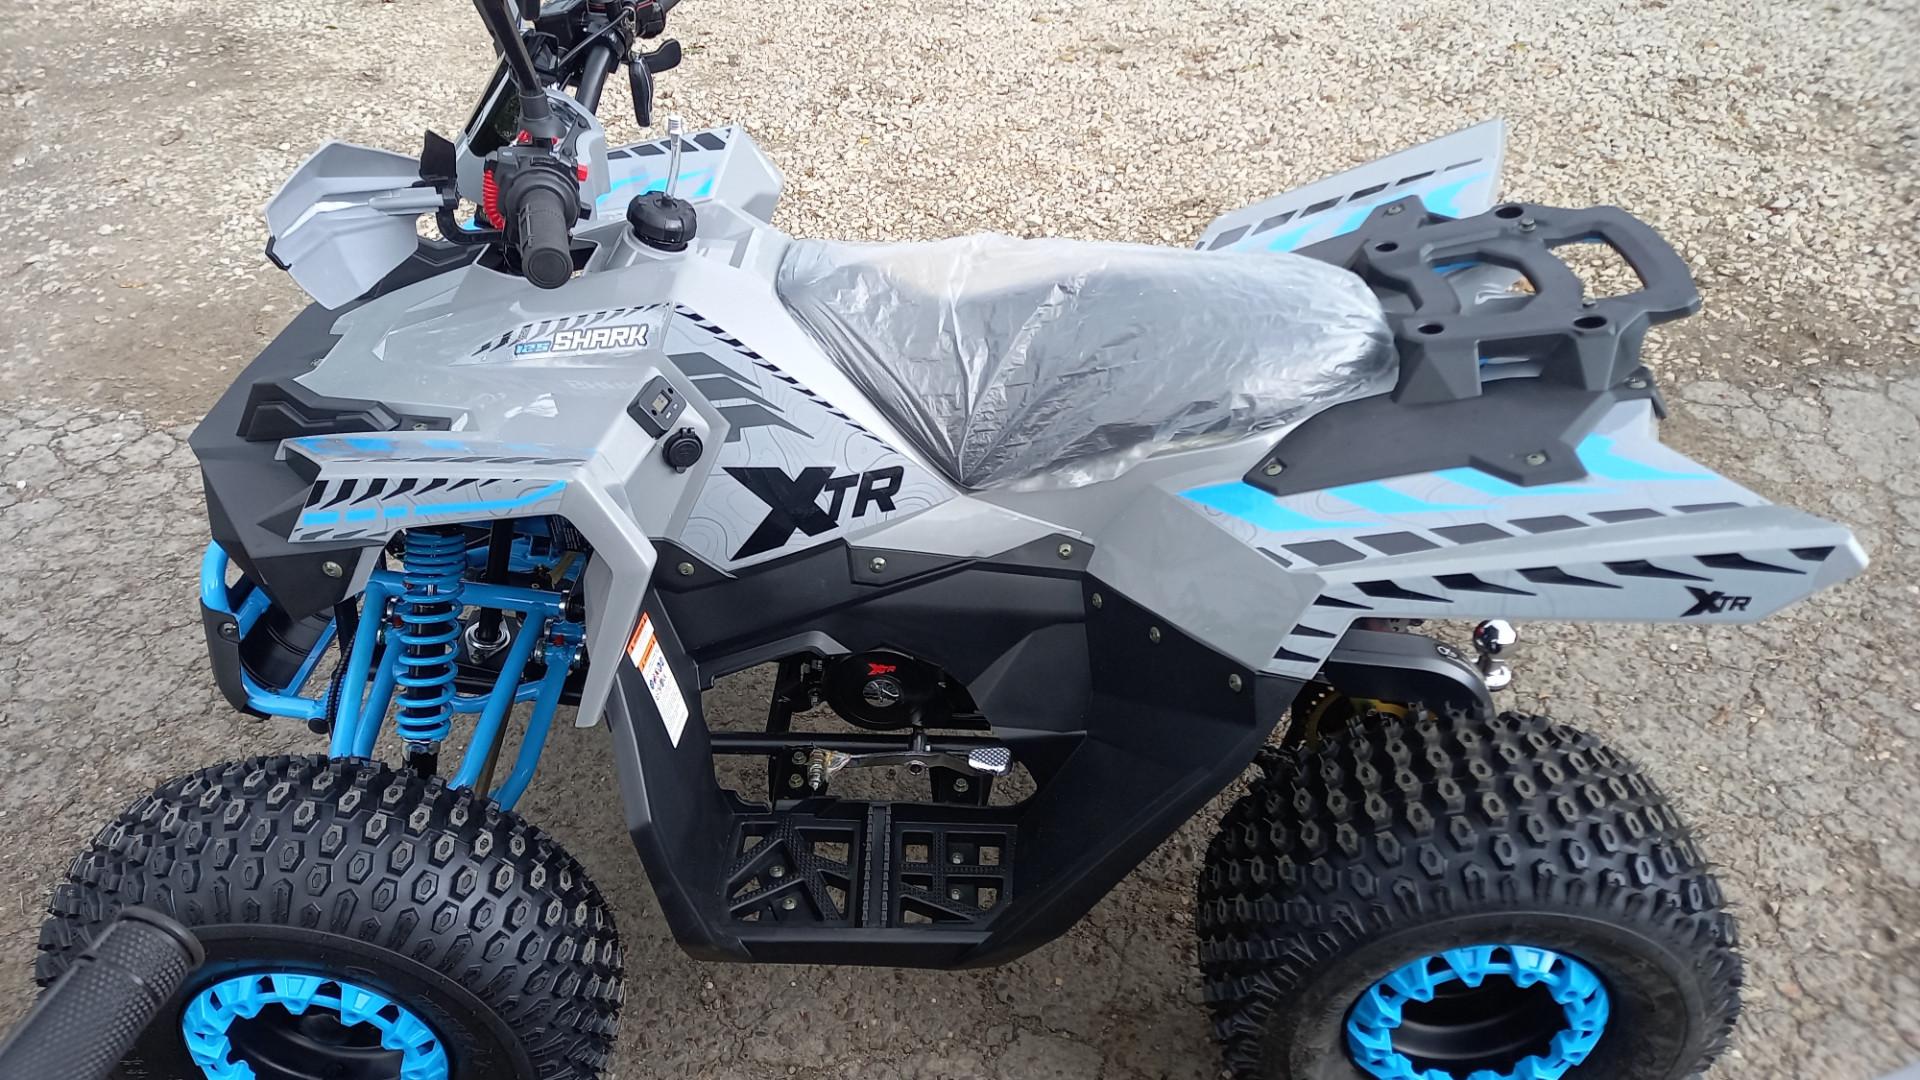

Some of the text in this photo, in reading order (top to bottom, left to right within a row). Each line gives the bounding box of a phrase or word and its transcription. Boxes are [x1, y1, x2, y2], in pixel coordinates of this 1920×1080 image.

[550, 324, 648, 351] SHARK
[721, 466, 904, 561] XTR
[1680, 586, 1752, 617] XTR
